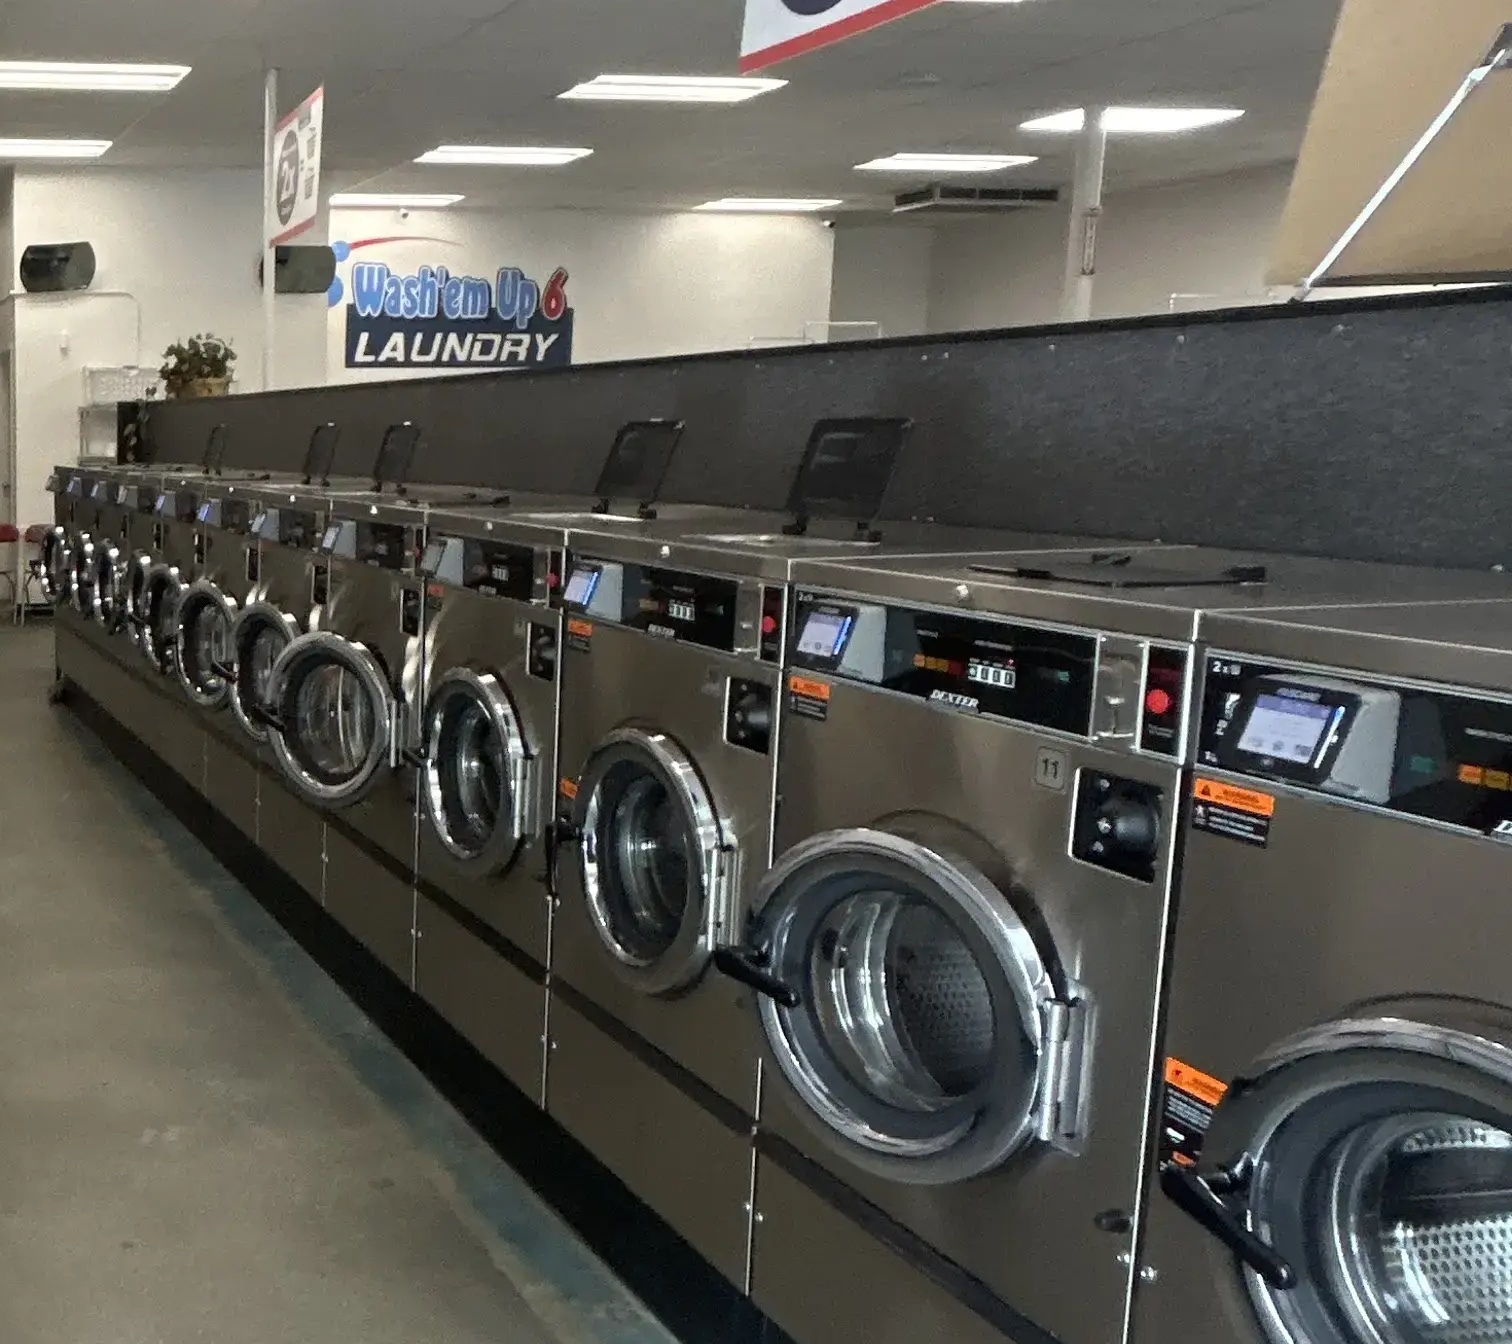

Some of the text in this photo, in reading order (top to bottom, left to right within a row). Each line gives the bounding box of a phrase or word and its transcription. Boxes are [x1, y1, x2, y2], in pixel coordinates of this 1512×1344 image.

[352, 262, 569, 331] Wash'em Up 6
[354, 331, 560, 363] LAUNDRY
[930, 688, 980, 708] DEXTER
